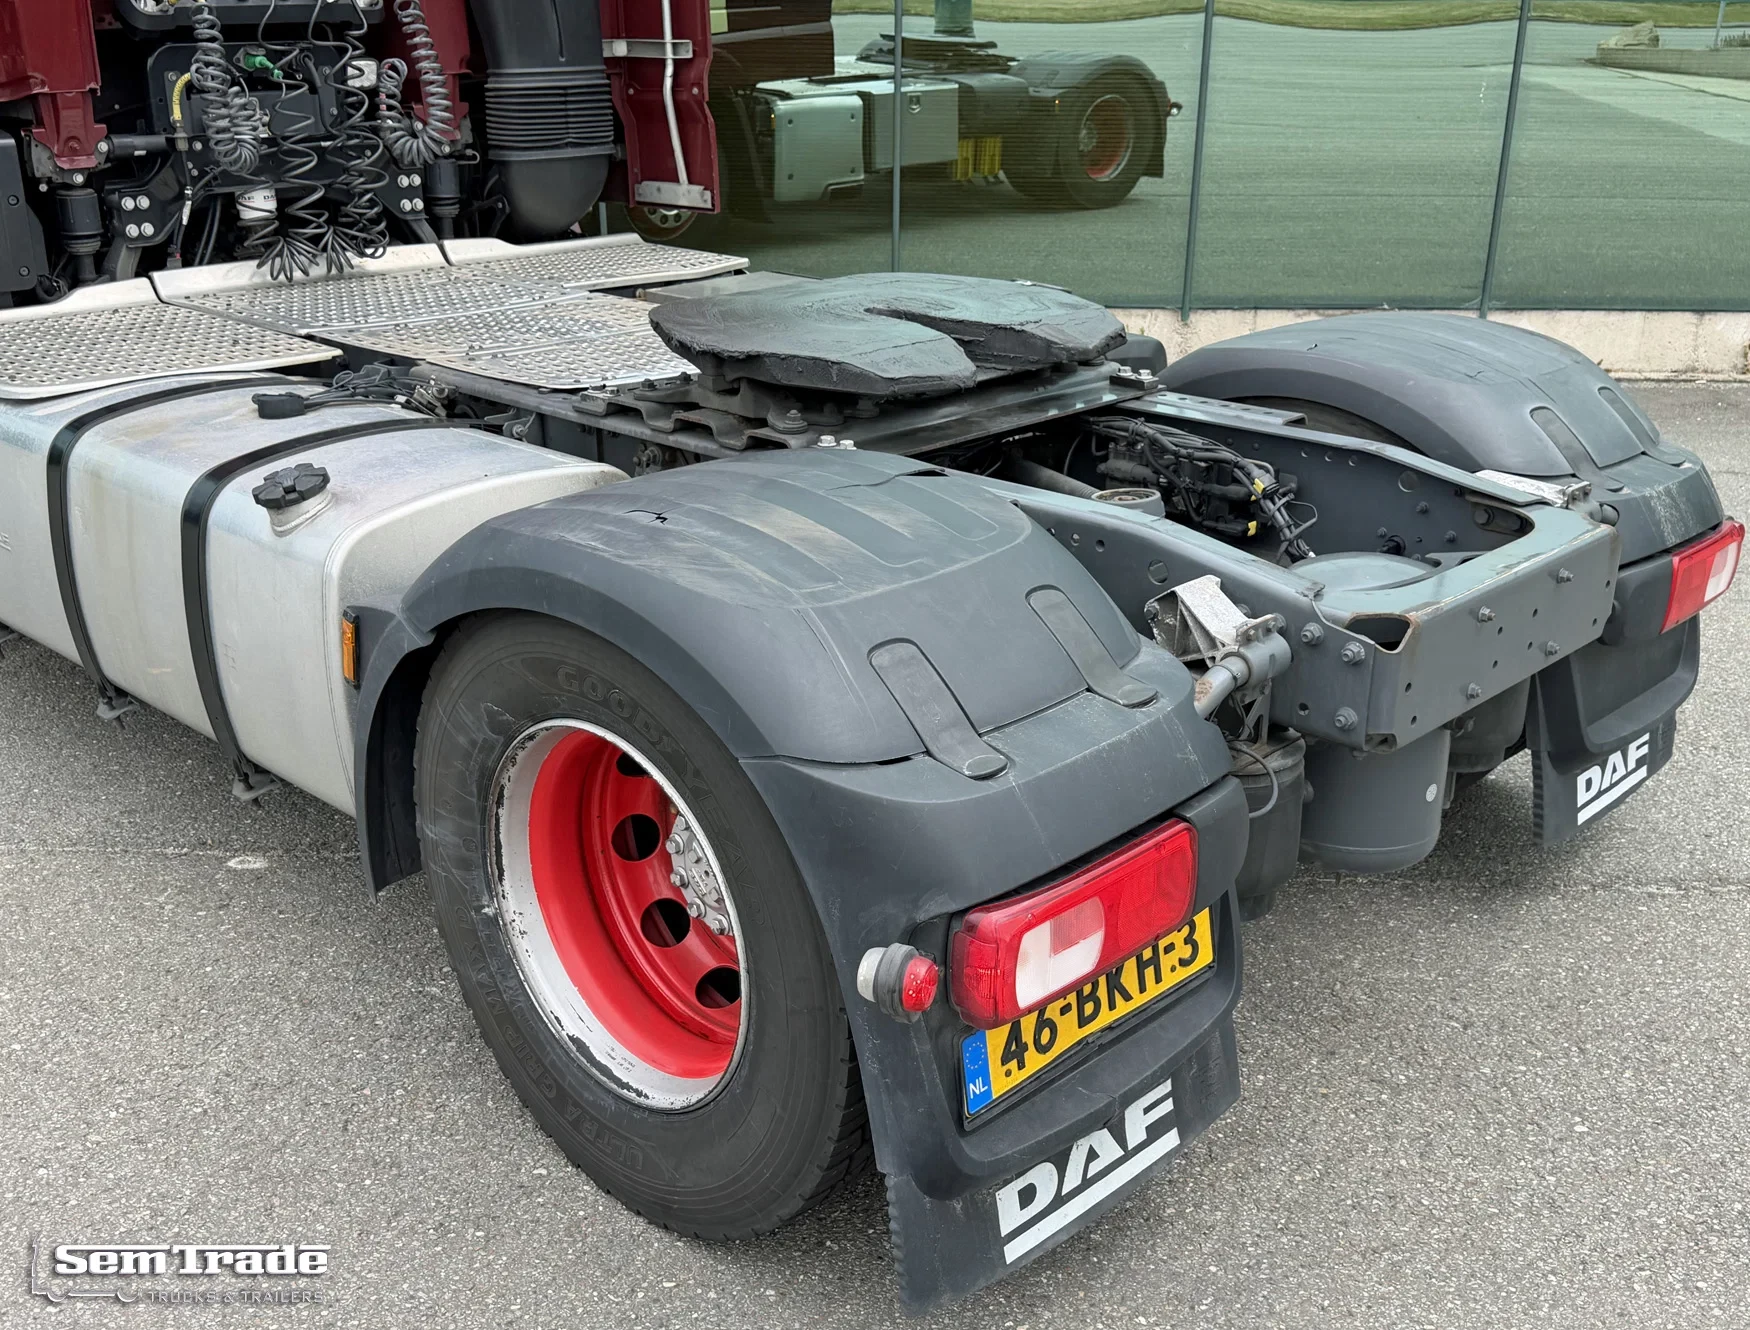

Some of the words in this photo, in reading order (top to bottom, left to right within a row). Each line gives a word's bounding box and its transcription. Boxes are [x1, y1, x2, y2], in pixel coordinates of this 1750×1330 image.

[1576, 731, 1650, 808] DAF
[1001, 917, 1200, 1071] 46-BKH-3
[503, 1026, 557, 1099] GRIP
[968, 1076, 989, 1099] NL
[563, 1097, 644, 1169] ULTRA
[994, 1076, 1174, 1237] DAF
